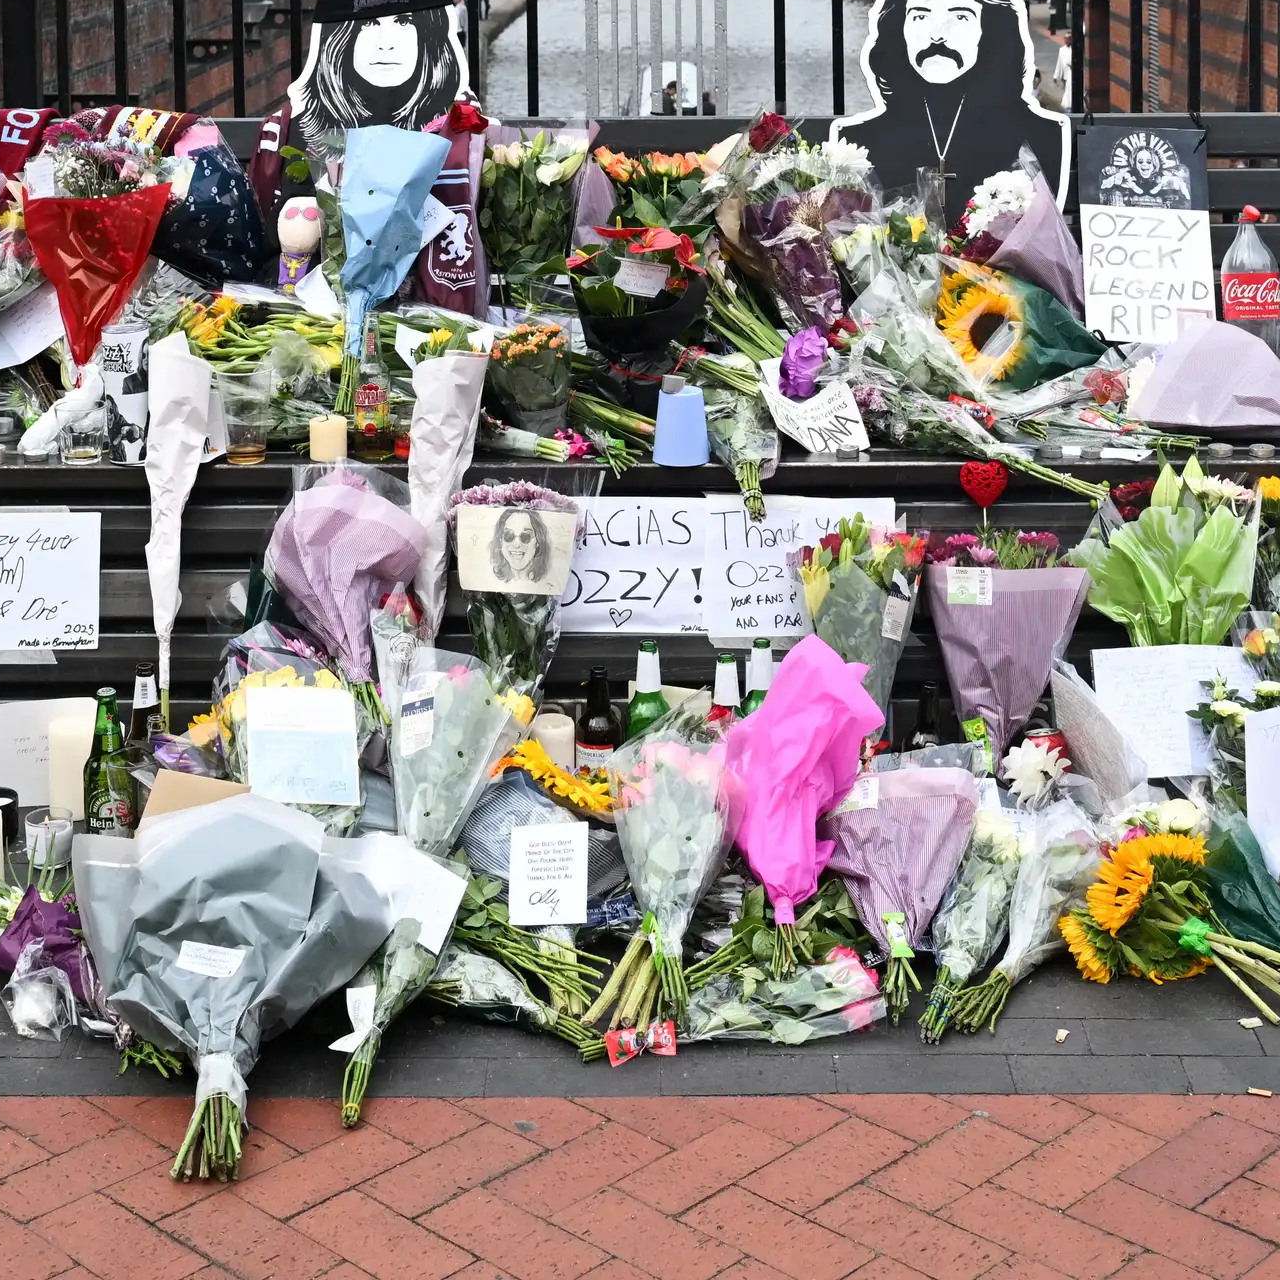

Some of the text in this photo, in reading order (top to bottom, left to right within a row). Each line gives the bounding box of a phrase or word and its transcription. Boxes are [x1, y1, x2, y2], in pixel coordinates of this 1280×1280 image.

[1113, 132, 1178, 169] UP THE VILLA
[1089, 211, 1200, 242] OZZY
[1090, 243, 1182, 269] ROCK
[434, 268, 457, 279] ASTON
[1089, 273, 1209, 301] LEGEND
[1111, 305, 1172, 338] RIP
[26, 528, 80, 551] 4ever
[710, 509, 804, 550] Thank
[731, 597, 752, 611] YOUR
[757, 594, 783, 605] FANS
[64, 624, 94, 634] 2025
[736, 617, 758, 628] AND
[18, 637, 95, 650] Made in Birmingham
[403, 704, 434, 717] FLORIST
[106, 723, 114, 754] Heineken
